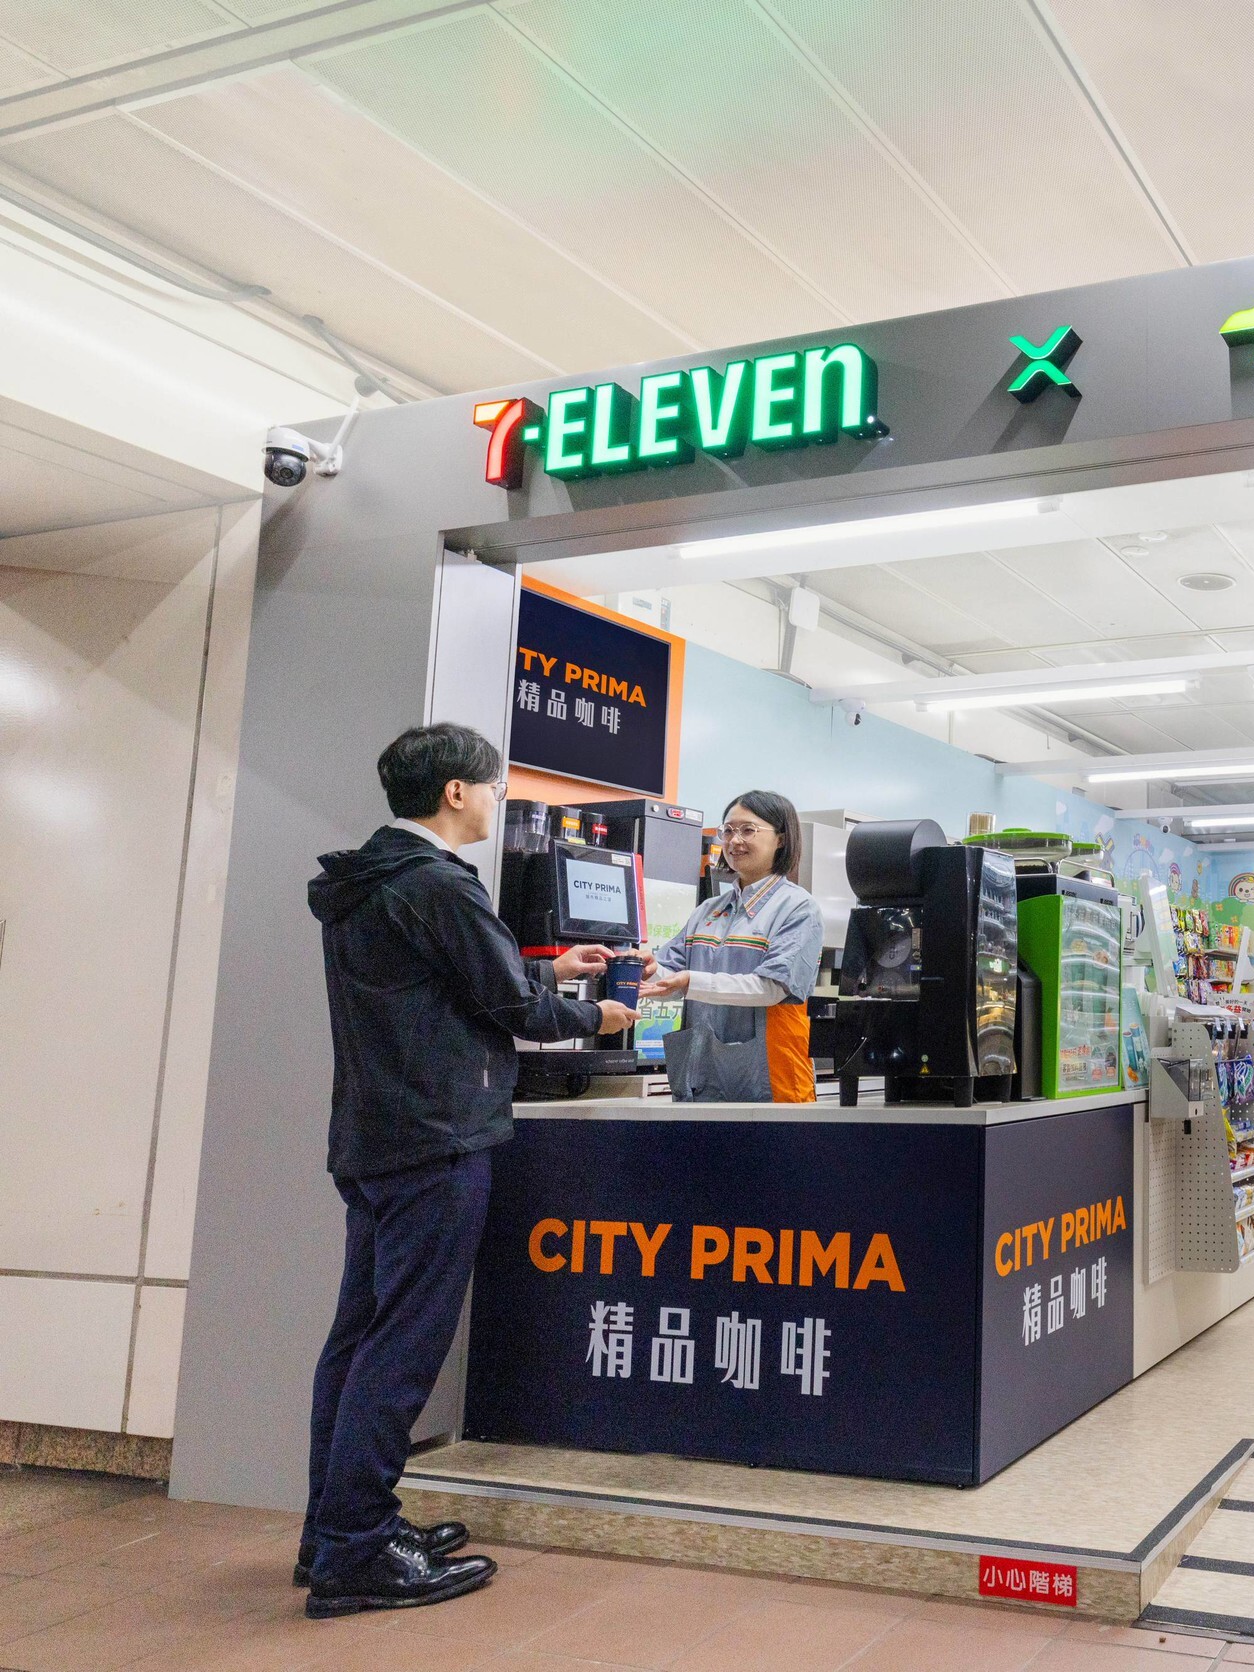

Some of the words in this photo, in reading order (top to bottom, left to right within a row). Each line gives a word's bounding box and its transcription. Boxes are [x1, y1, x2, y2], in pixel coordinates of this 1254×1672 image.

[516, 679, 621, 735] 精品咖啡
[565, 662, 647, 708] PRIMA
[573, 880, 593, 890] CITY
[595, 883, 622, 894] PRIMA
[528, 1217, 673, 1277] CITY
[690, 1225, 906, 1292] PRIMA
[995, 1218, 1056, 1278] CITY
[1060, 1195, 1127, 1253] PRIMA
[1022, 1255, 1109, 1347] 精品咖啡
[585, 1301, 833, 1396] 精品咖啡
[983, 1565, 1073, 1597] 小心階梯
